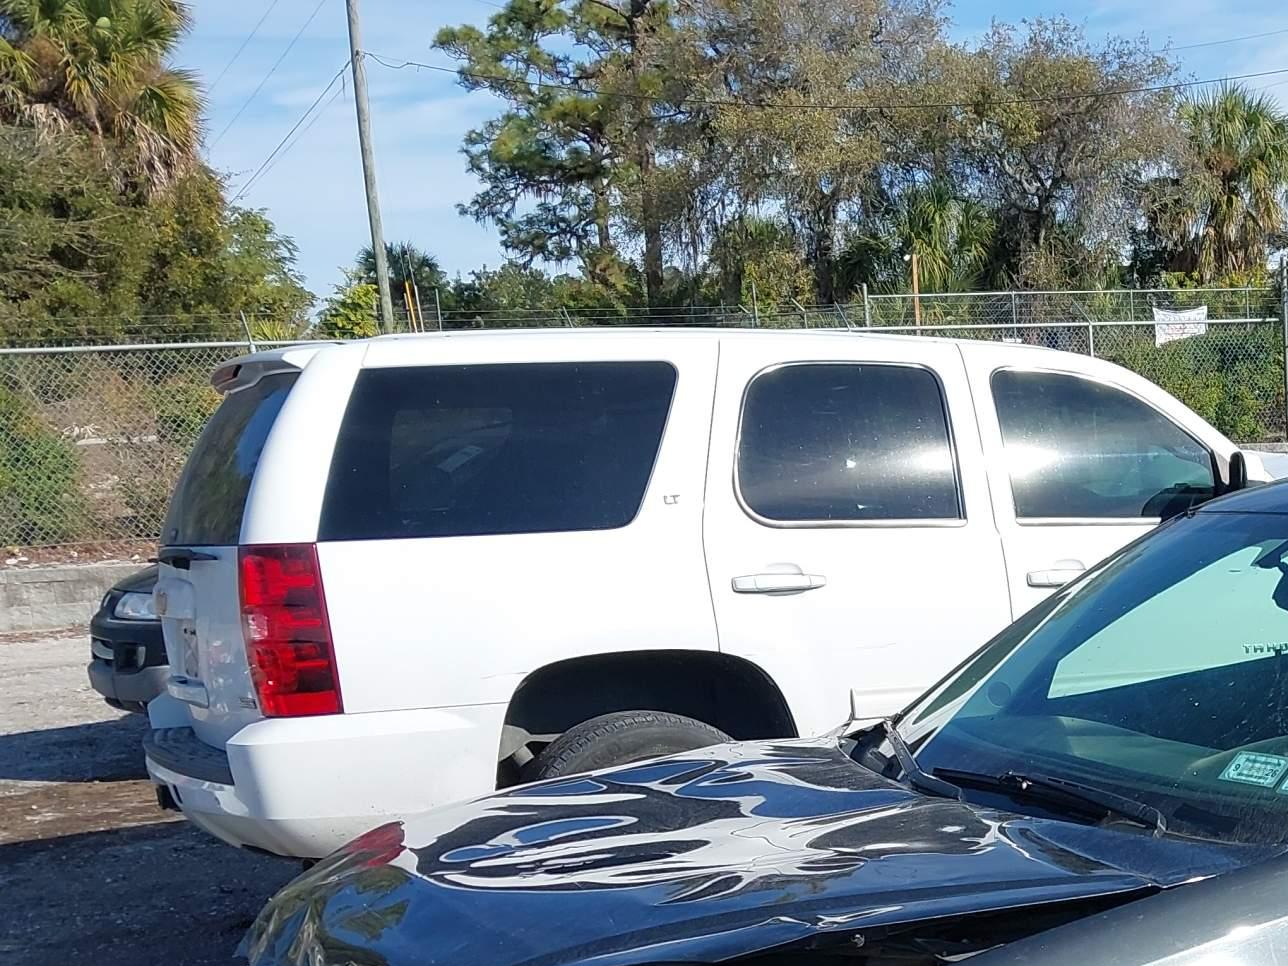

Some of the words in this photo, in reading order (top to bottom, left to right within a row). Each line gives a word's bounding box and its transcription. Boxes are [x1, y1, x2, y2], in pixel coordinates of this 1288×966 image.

[663, 494, 681, 505] LT
[1232, 763, 1241, 772] 9
[1265, 768, 1280, 778] 26
